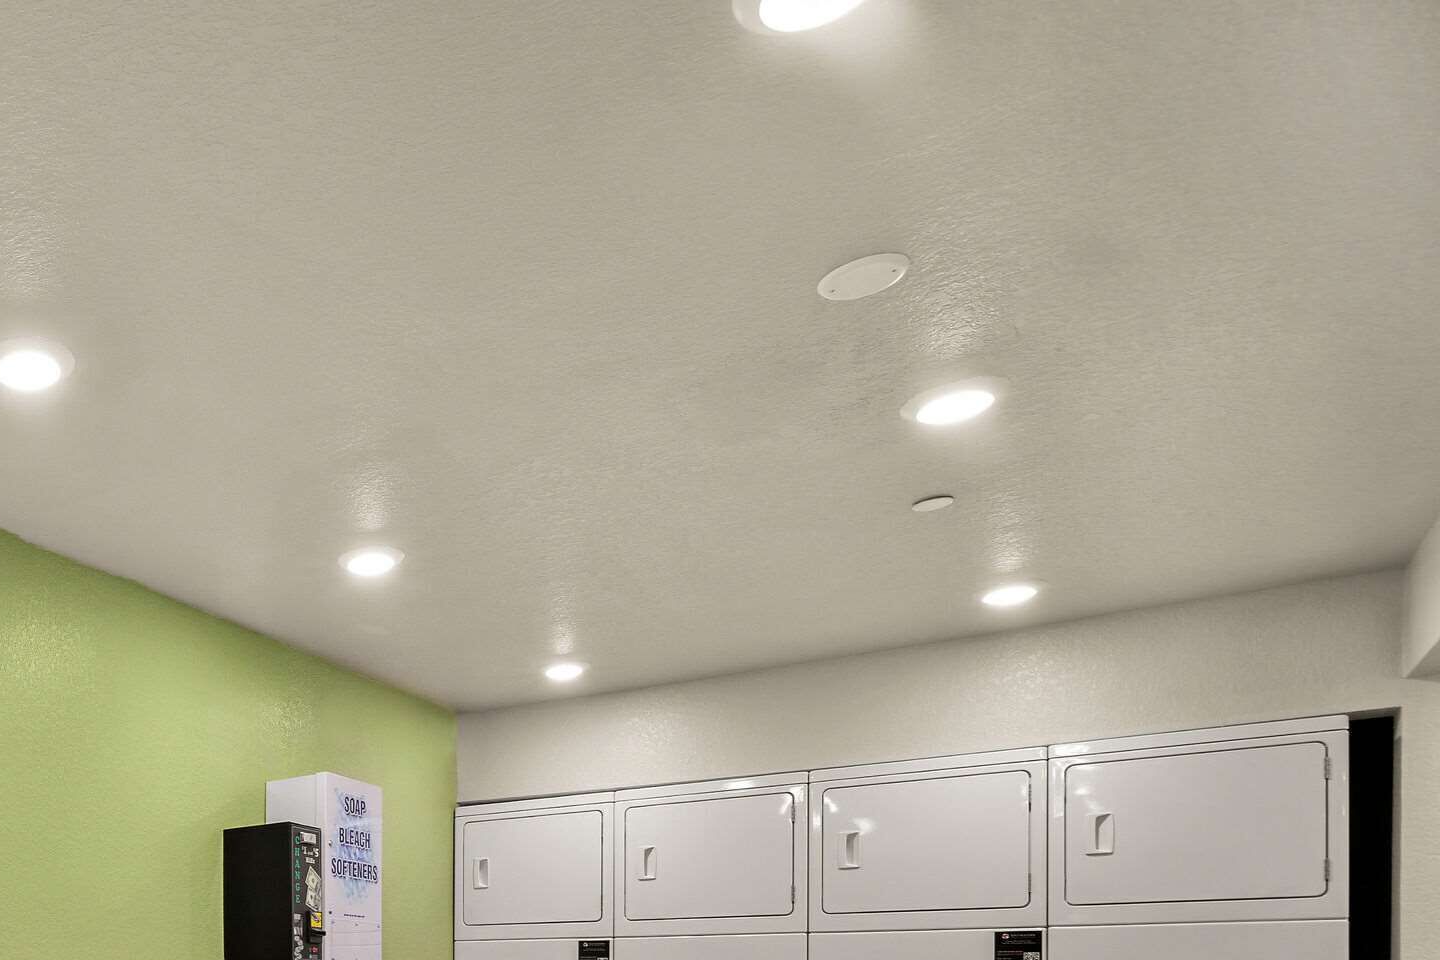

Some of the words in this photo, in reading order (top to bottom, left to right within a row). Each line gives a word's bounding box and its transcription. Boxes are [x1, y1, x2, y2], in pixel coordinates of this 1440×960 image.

[344, 797, 366, 815] SOAP
[339, 827, 370, 848] BLEACH
[331, 857, 378, 880] SOFTENERS
